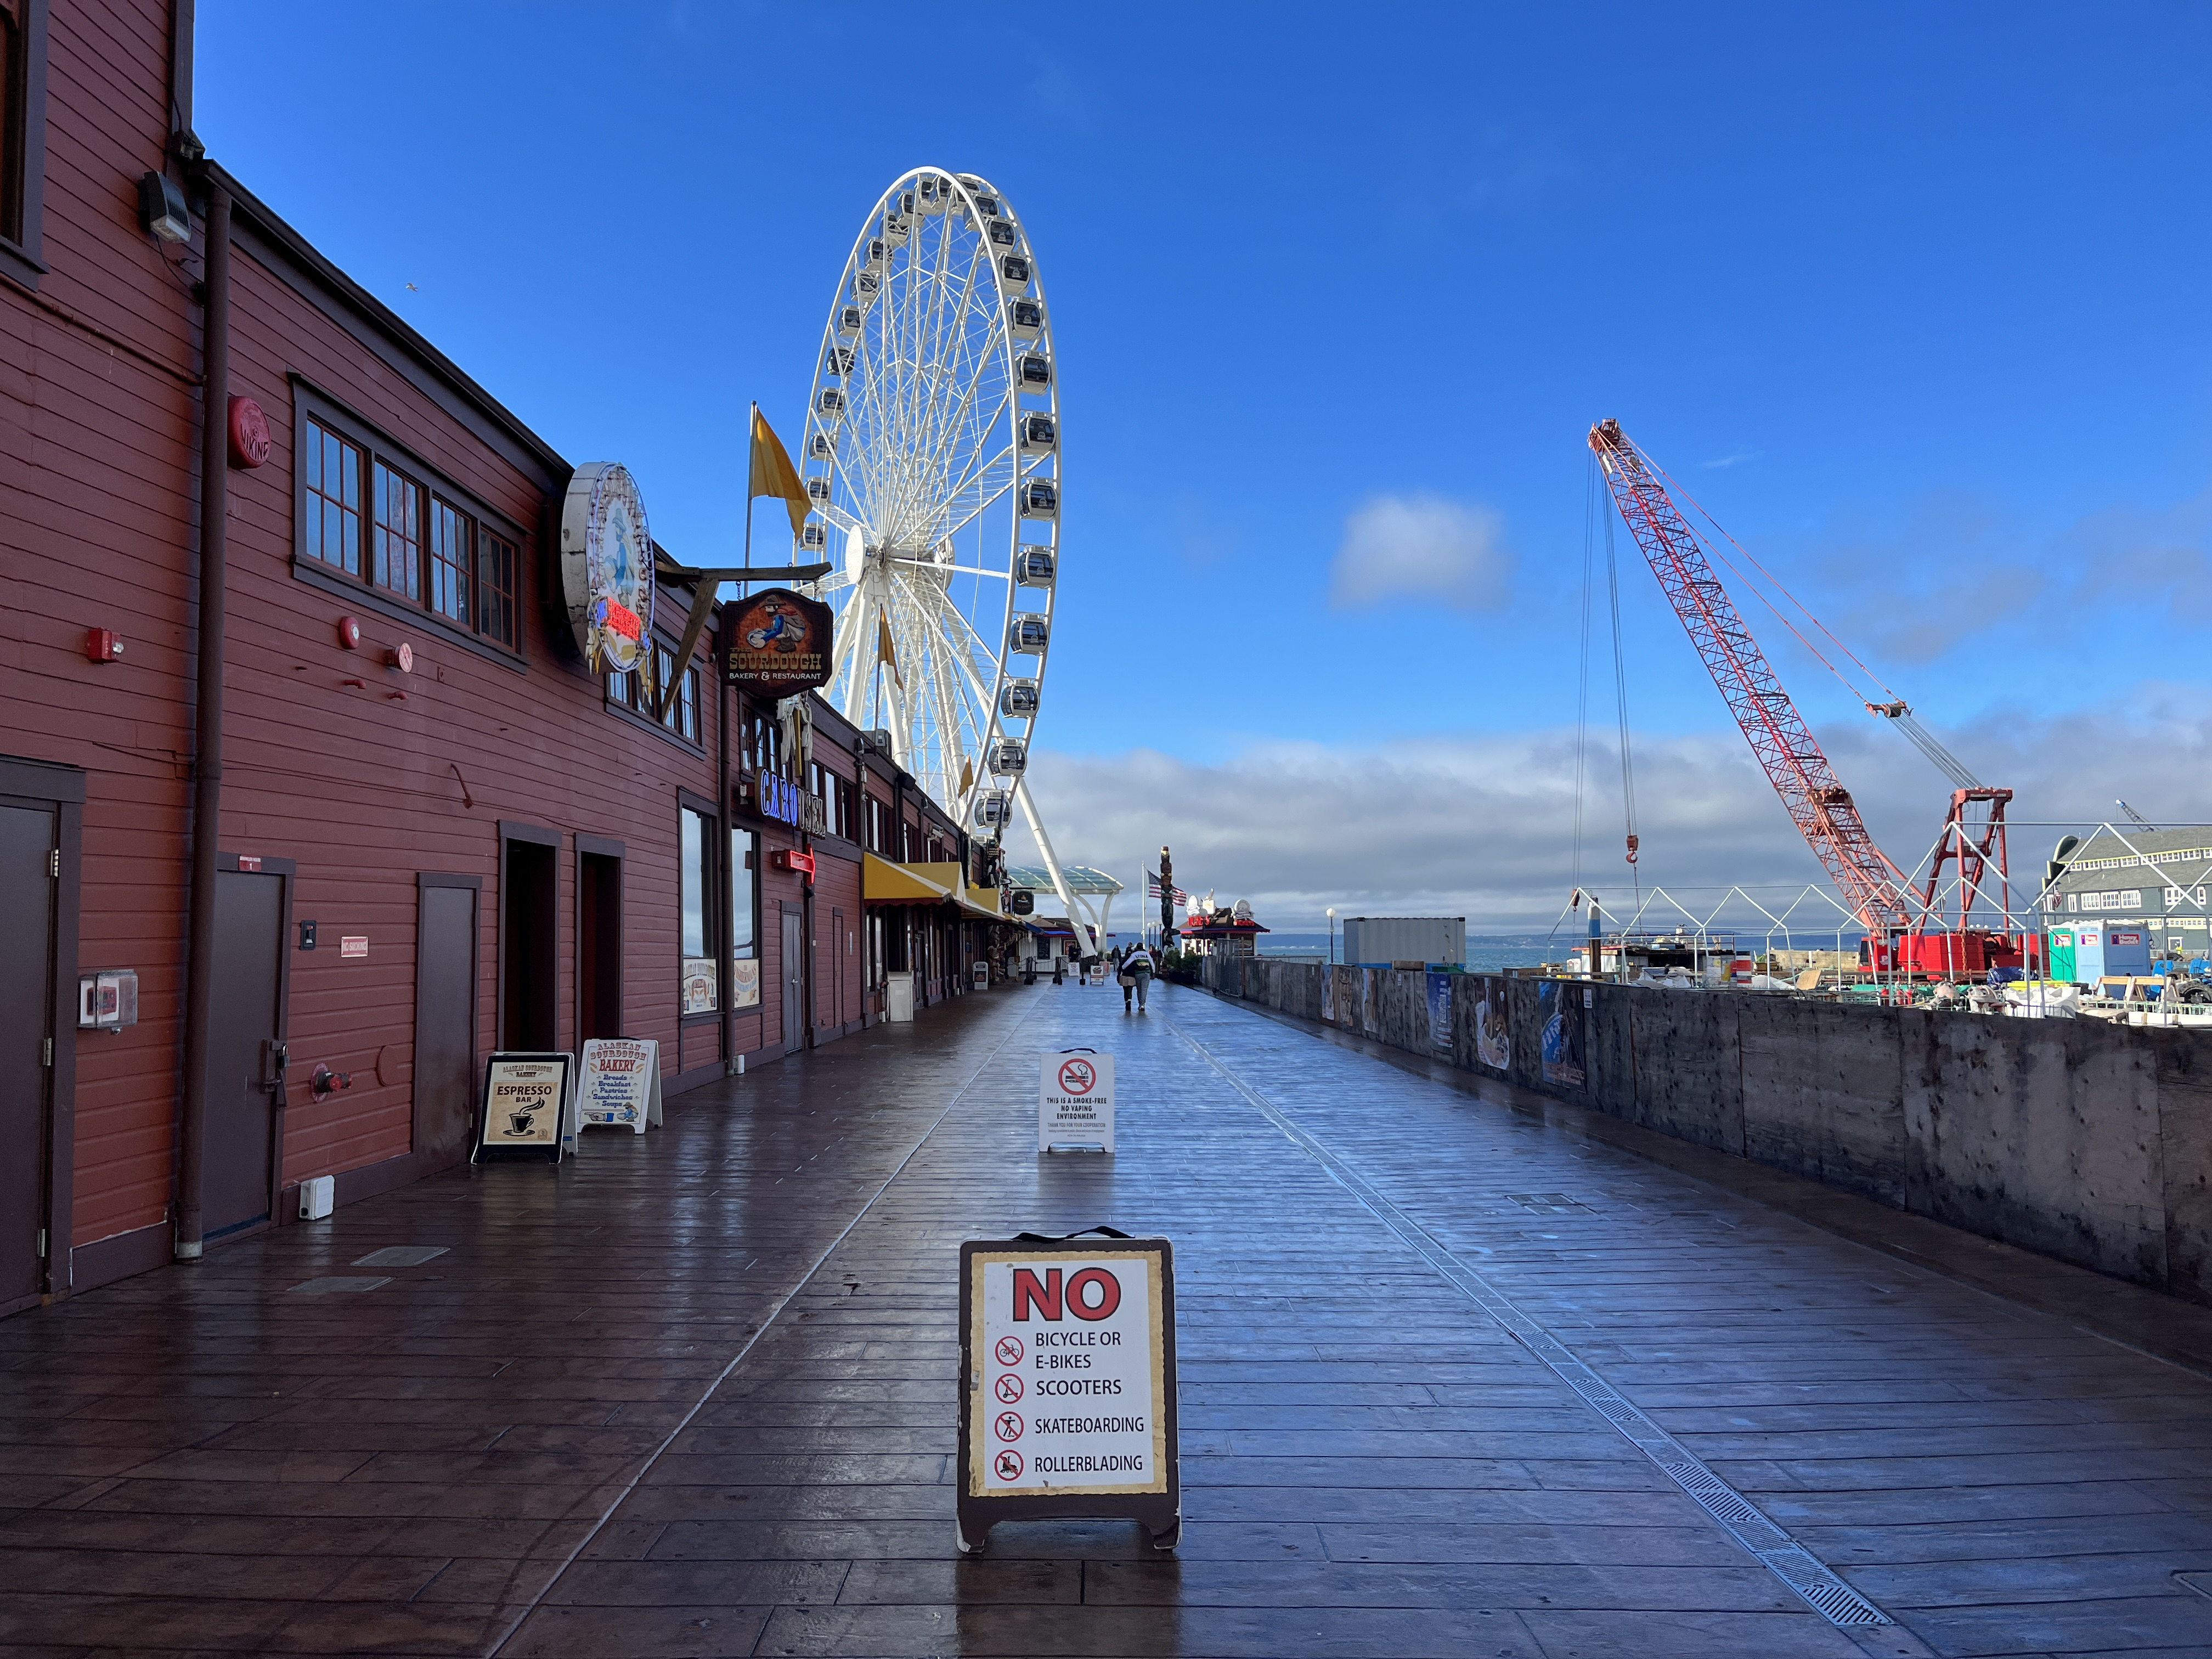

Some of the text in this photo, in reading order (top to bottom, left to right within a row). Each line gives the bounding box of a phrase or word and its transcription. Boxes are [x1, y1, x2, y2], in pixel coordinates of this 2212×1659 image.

[240, 423, 268, 460] VIKING
[729, 653, 822, 670] SOURDOUGH
[761, 672, 769, 681] &
[760, 769, 826, 837] CAROUSEL
[597, 1042, 641, 1051] ALASKAN
[590, 1050, 647, 1060] SOURDOUGH
[599, 1059, 636, 1071] BAKERY
[497, 1086, 552, 1095] ESPRESSO
[1013, 1267, 1121, 1322] NO
[1036, 1332, 1121, 1346] BICYCLE OR
[1036, 1355, 1091, 1369] E-BIKES
[1036, 1380, 1122, 1396] SCOOTERS
[1035, 1417, 1144, 1434] SKATEBOARDING
[1035, 1455, 1143, 1473] ROLLERBLADING
